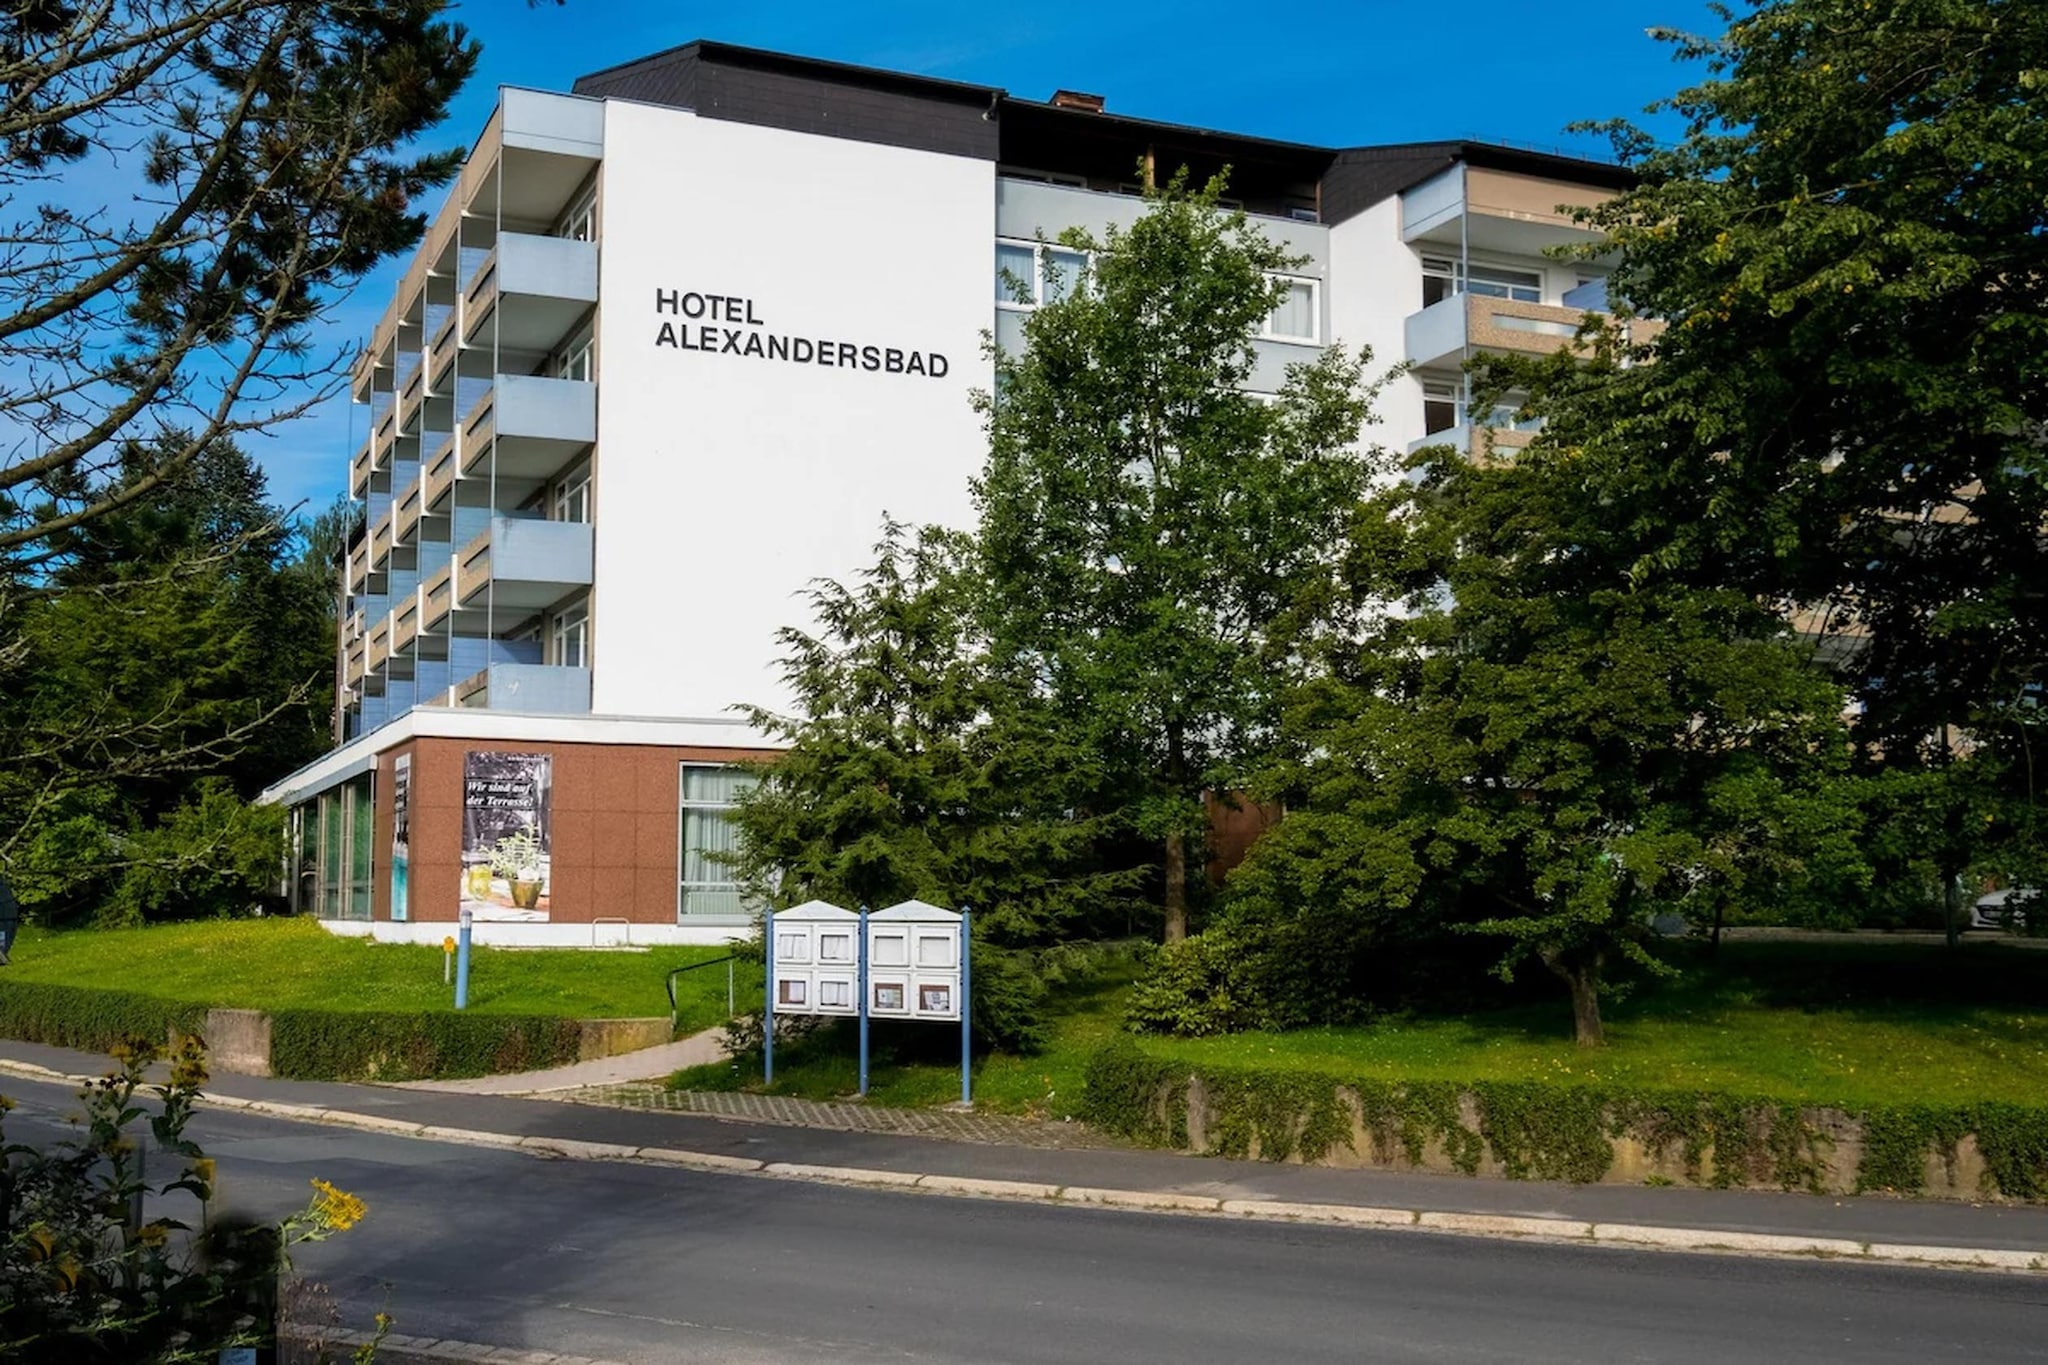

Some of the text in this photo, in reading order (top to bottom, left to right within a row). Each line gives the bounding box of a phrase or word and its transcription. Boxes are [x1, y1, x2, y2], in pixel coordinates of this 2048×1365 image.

[656, 288, 764, 326] HOTEL
[655, 322, 949, 378] ALEXANDERSBAD
[466, 795, 534, 807] der Terrasse!
[468, 781, 533, 795] Wir sind auf
